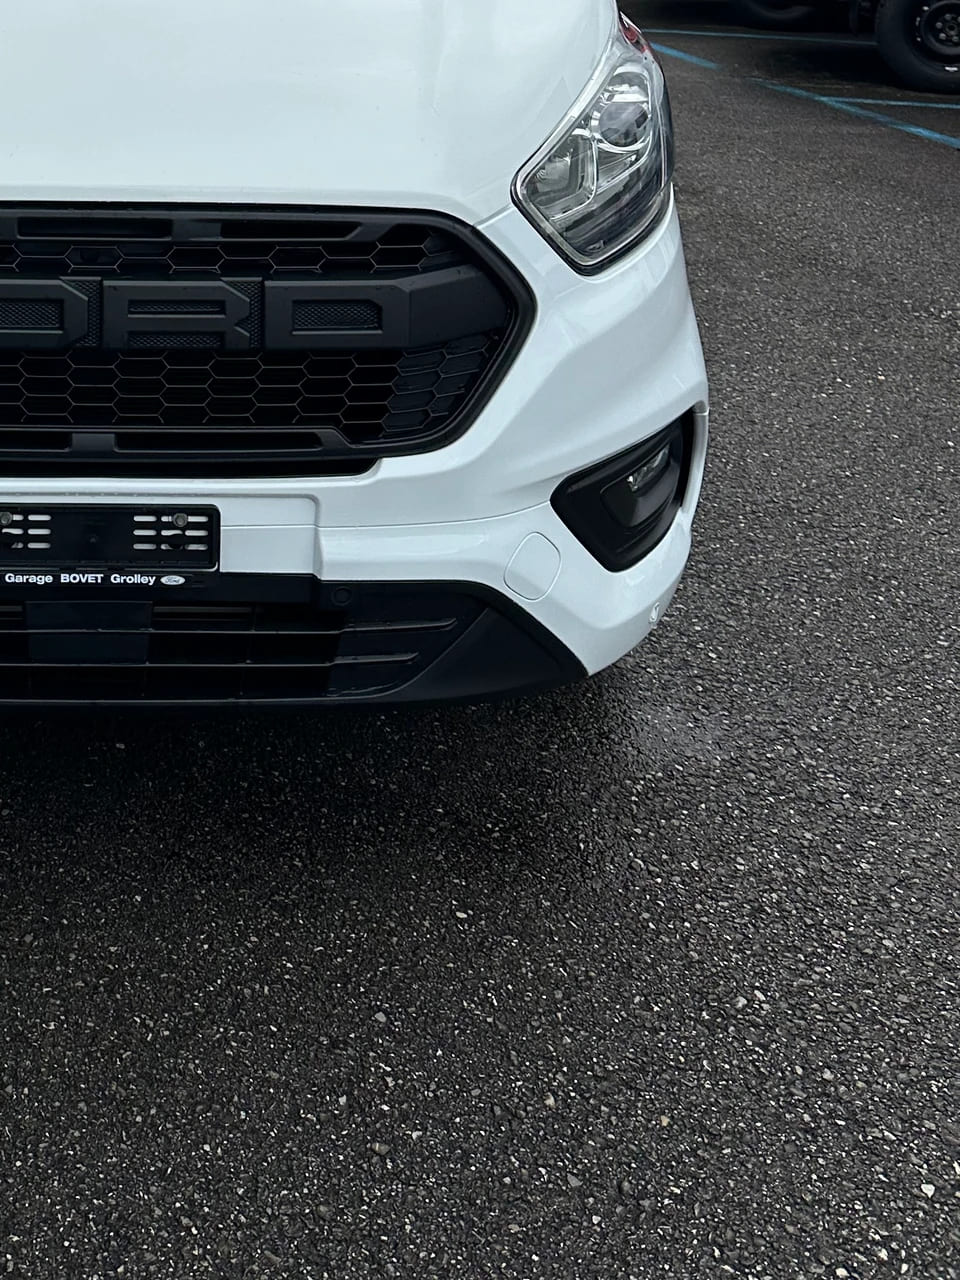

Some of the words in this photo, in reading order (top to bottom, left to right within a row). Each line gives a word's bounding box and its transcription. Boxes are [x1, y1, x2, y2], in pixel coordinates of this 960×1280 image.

[4, 573, 54, 585] Garage
[60, 573, 104, 584] BOVET
[110, 573, 156, 586] Grolley
